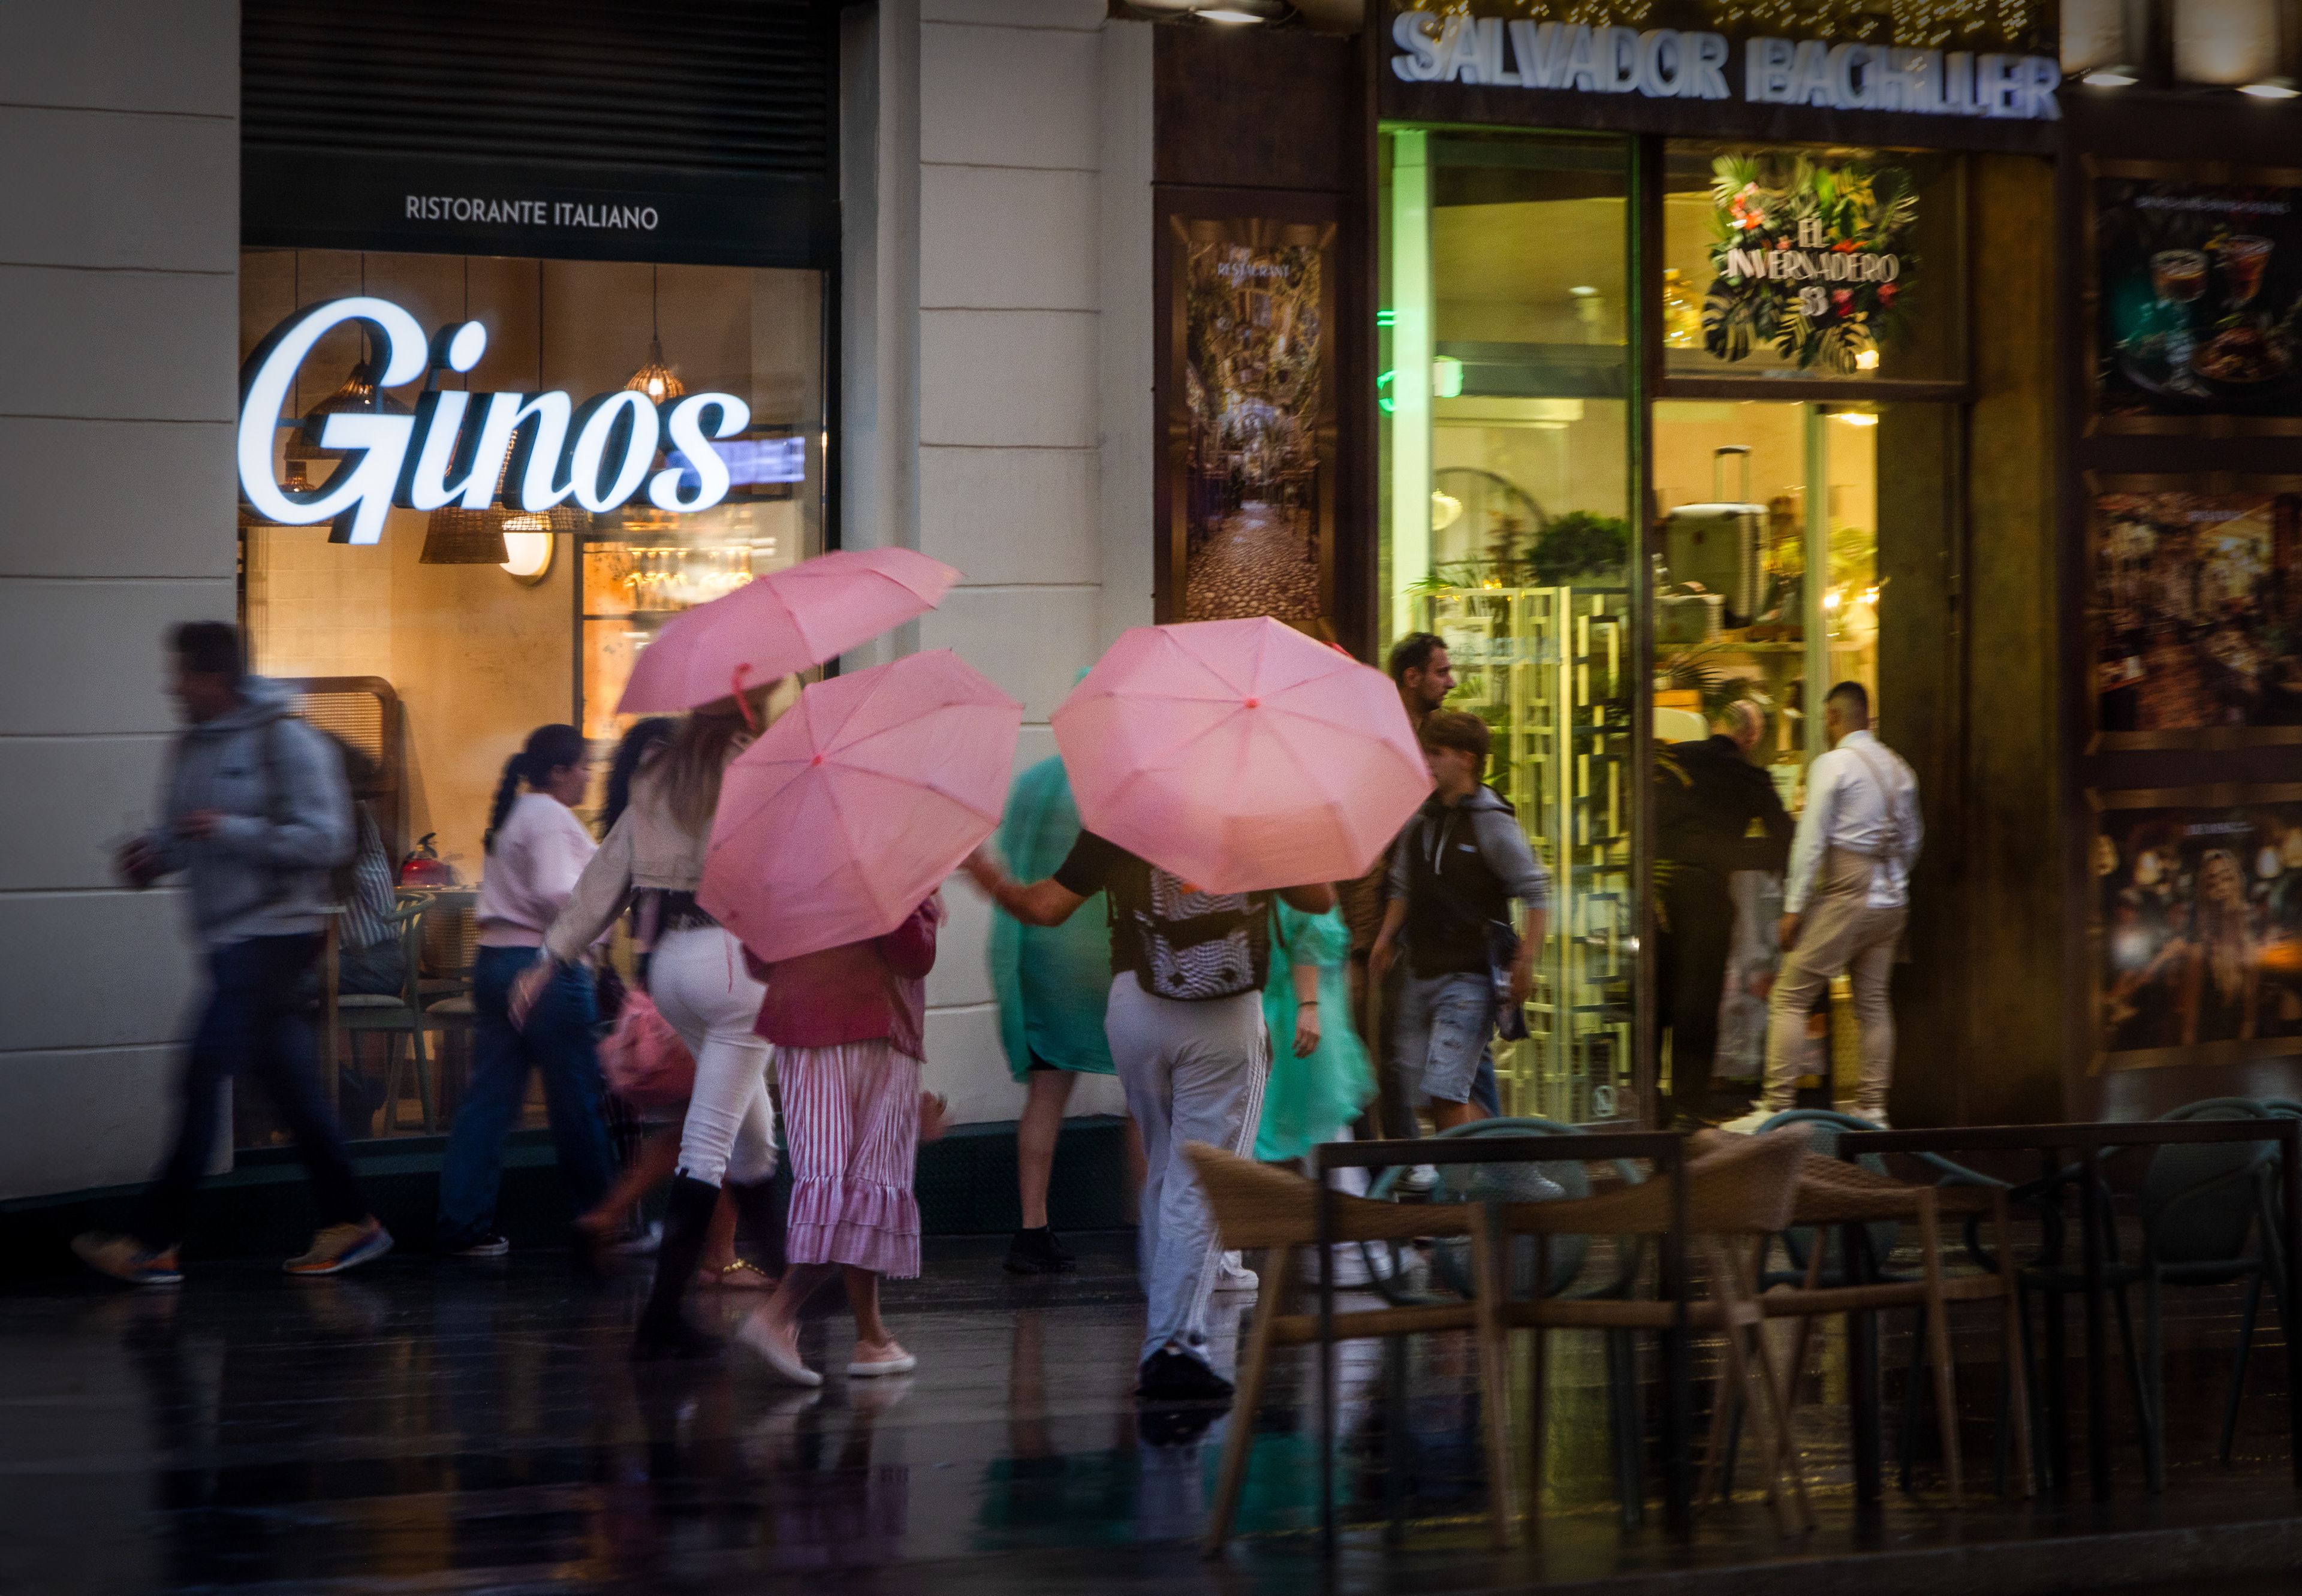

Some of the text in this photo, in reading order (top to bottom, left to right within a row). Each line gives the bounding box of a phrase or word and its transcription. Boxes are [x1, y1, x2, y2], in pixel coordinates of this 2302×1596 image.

[1391, 11, 1732, 100] SALVADOR
[406, 195, 659, 230] RISTORANTE ITALIANO
[1798, 218, 1830, 248] EL
[237, 296, 751, 545] Ginos
